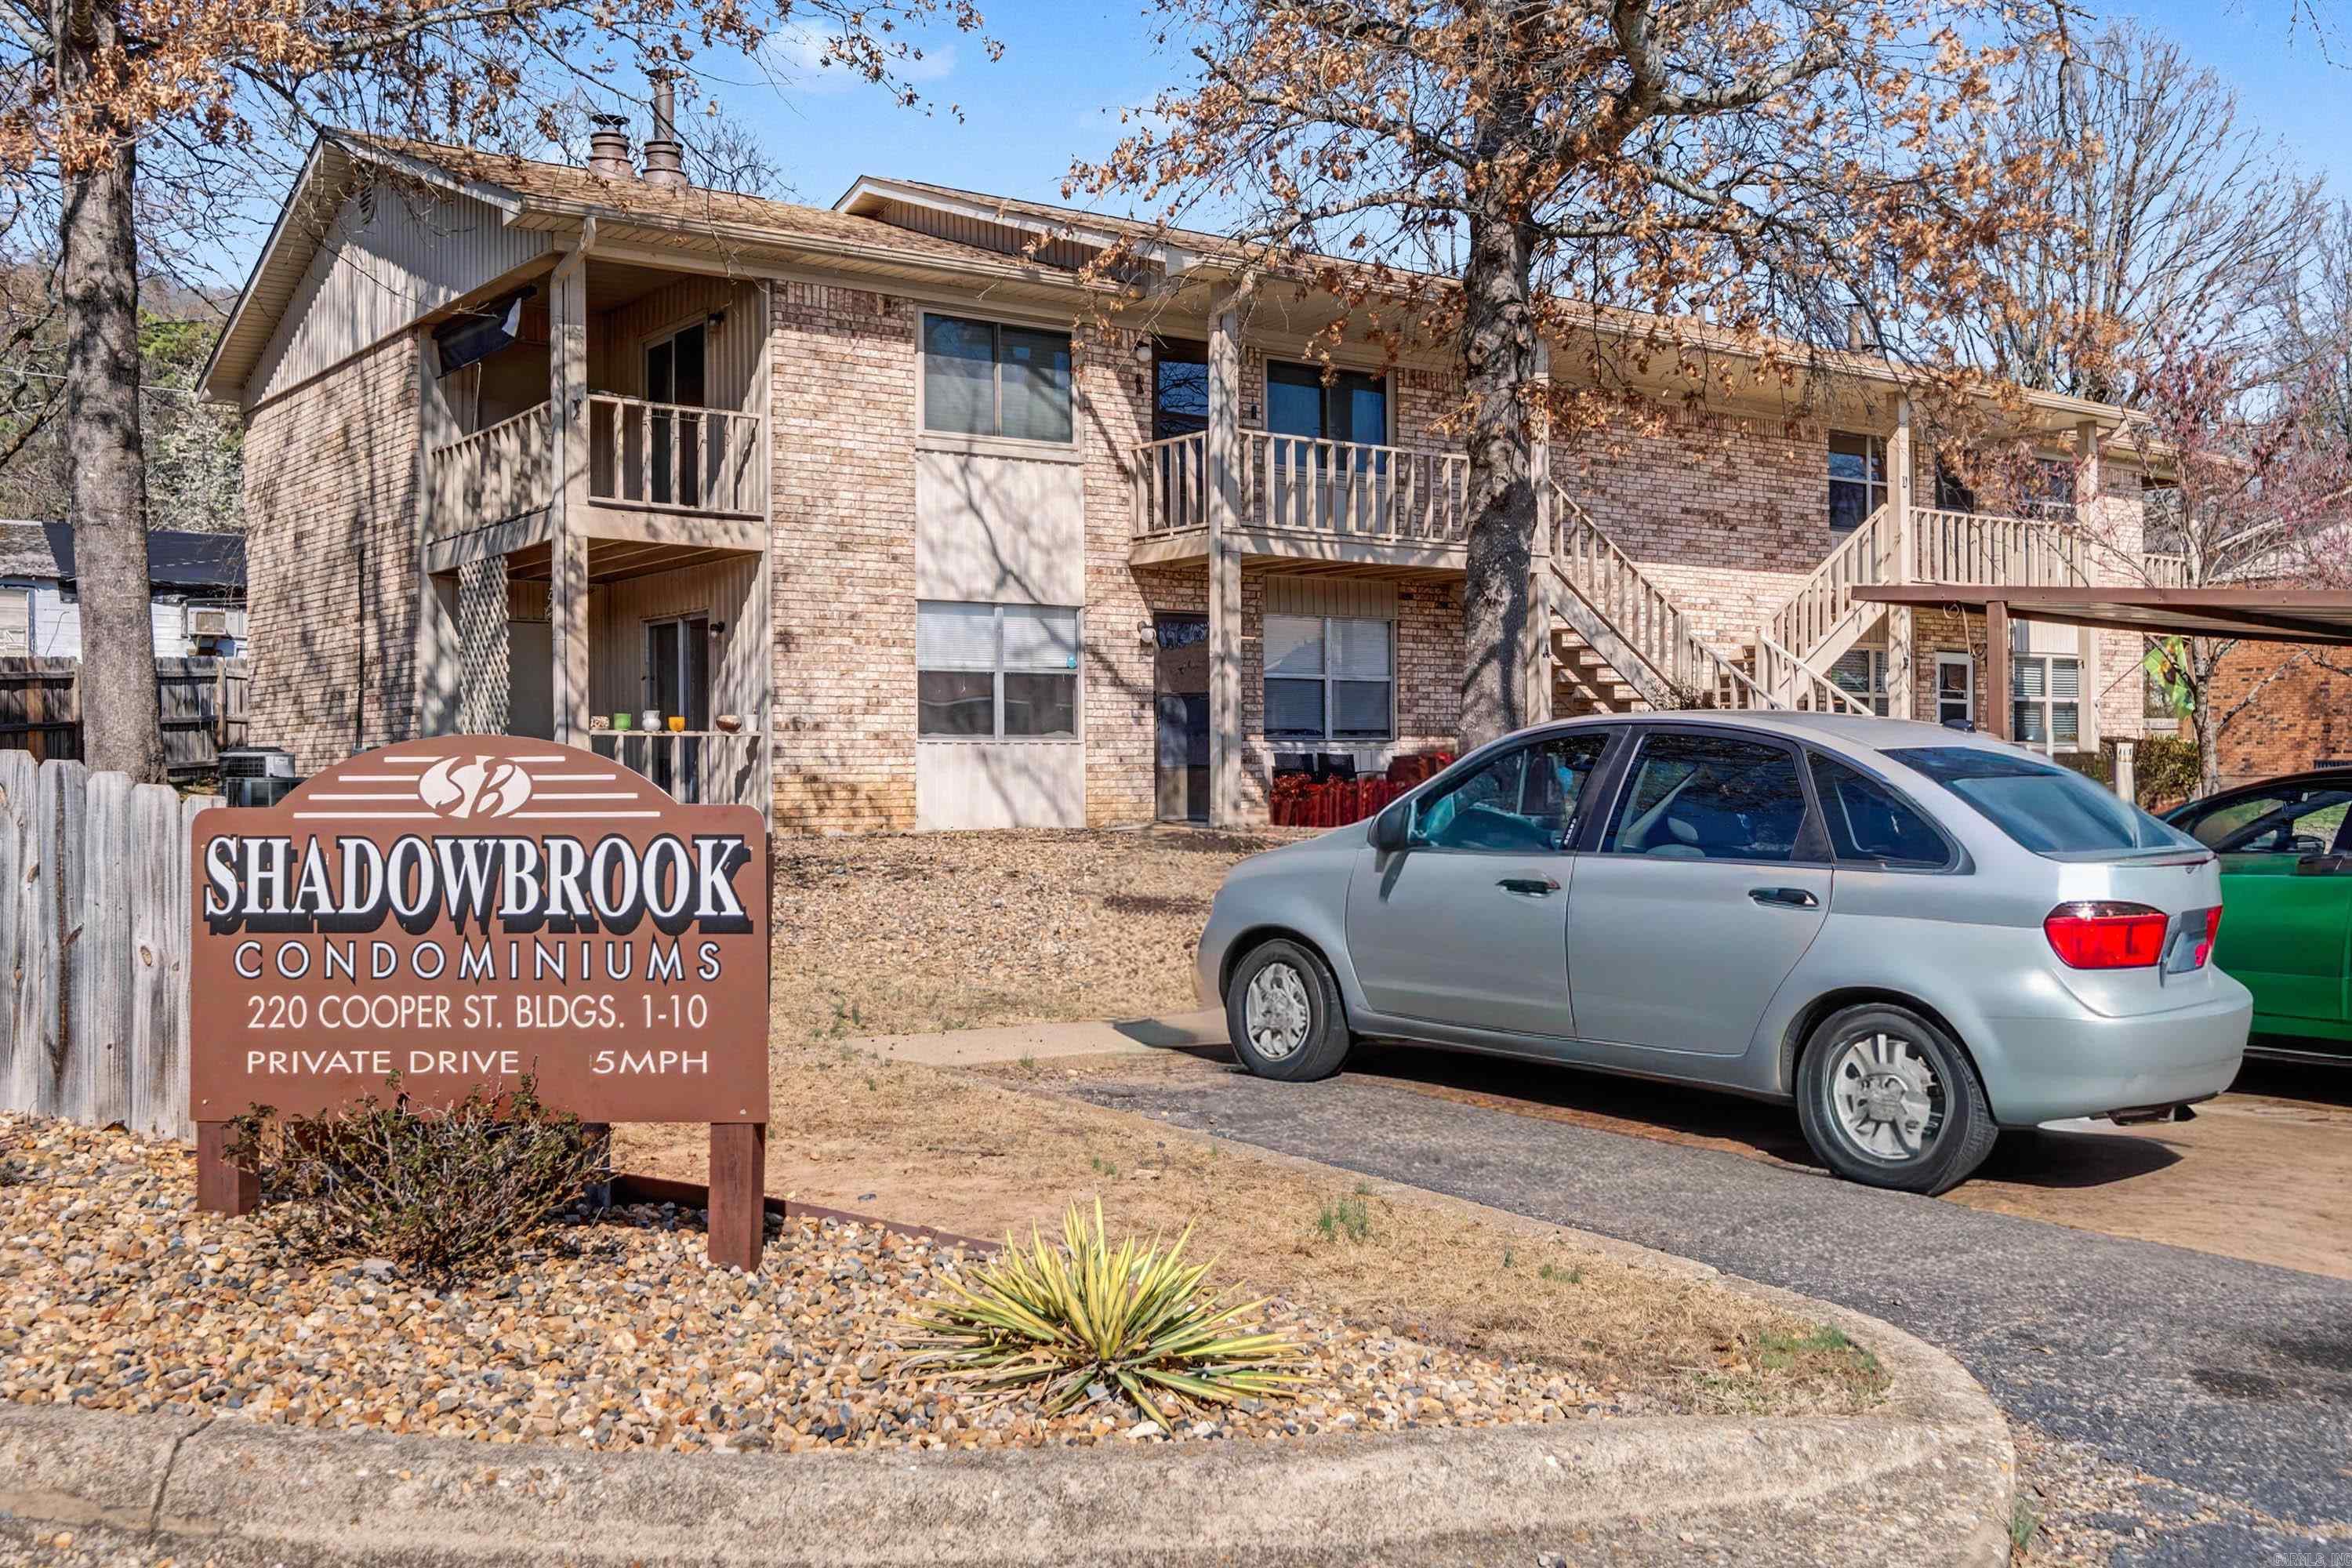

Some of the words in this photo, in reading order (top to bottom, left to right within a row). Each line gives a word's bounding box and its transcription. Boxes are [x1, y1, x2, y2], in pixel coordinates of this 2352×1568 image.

[204, 833, 753, 935] SHADOWBROOK
[234, 935, 721, 985] CONDOMINIUMS
[248, 995, 307, 1029] 220
[318, 995, 452, 1029] COOPER
[463, 994, 502, 1029] ST.
[516, 994, 625, 1029] BLDGS.
[642, 994, 708, 1029] 1-10
[247, 1050, 391, 1074] PRIVATE
[409, 1050, 519, 1074] DRIVE
[592, 1050, 708, 1074] 5MPH
